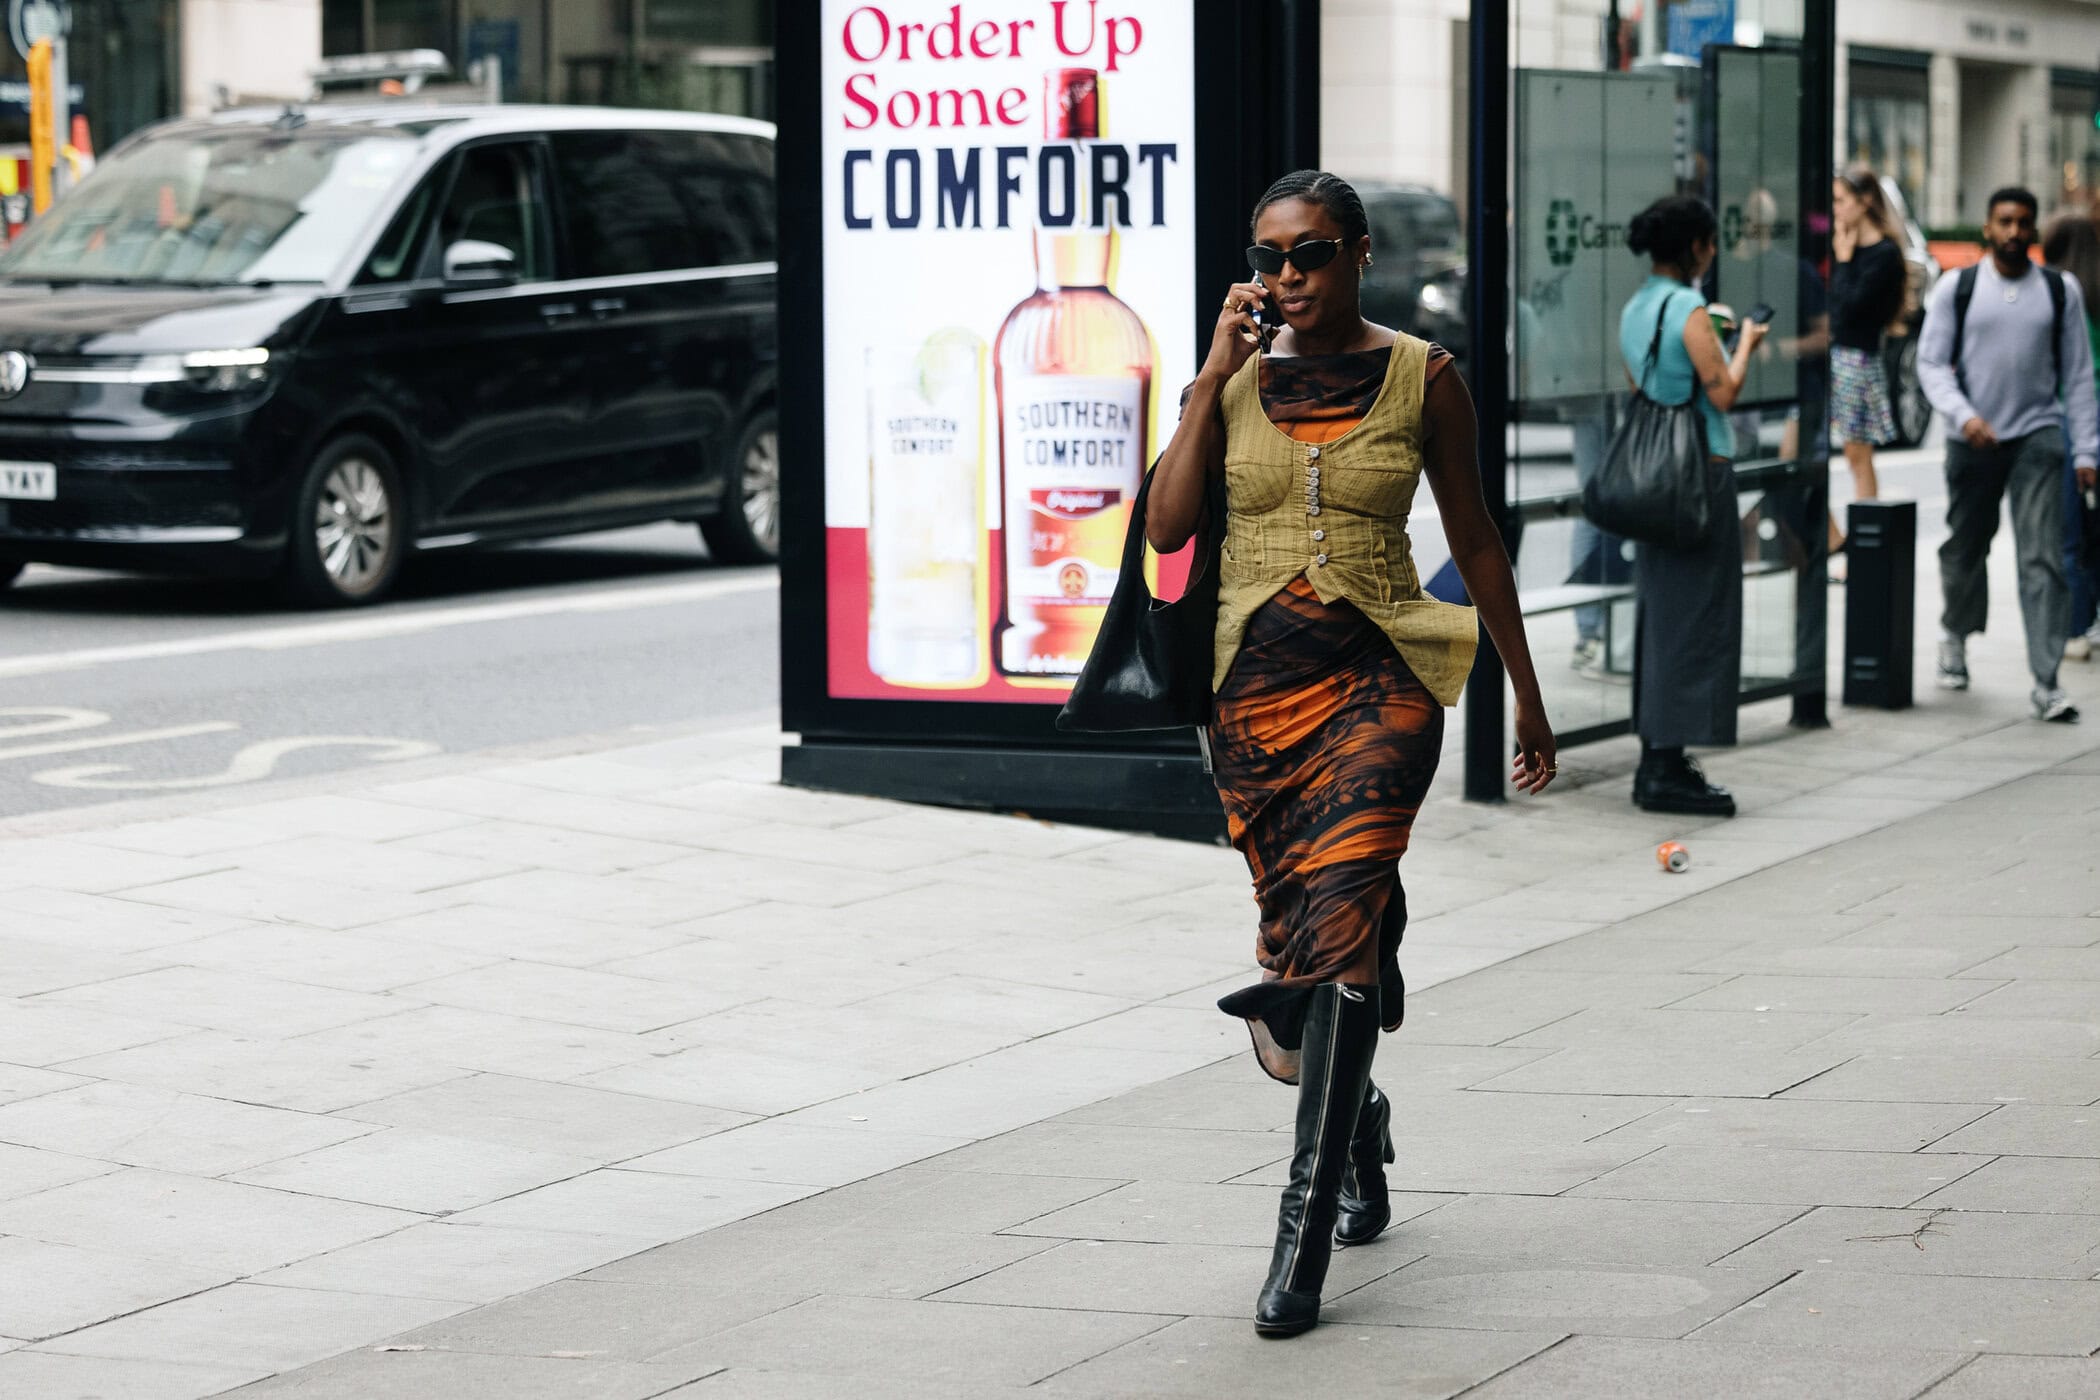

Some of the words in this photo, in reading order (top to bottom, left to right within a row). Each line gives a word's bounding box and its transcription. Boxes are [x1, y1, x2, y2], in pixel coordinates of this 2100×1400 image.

[842, 4, 1034, 62] Order
[1050, 0, 1143, 71] Up
[843, 73, 1029, 130] Some
[843, 143, 1178, 229] COMFORT
[887, 415, 958, 434] SOUTHERN
[1017, 401, 1134, 434] SOUTHERN
[891, 438, 953, 455] COMFORT
[1024, 439, 1125, 467] COMFORT
